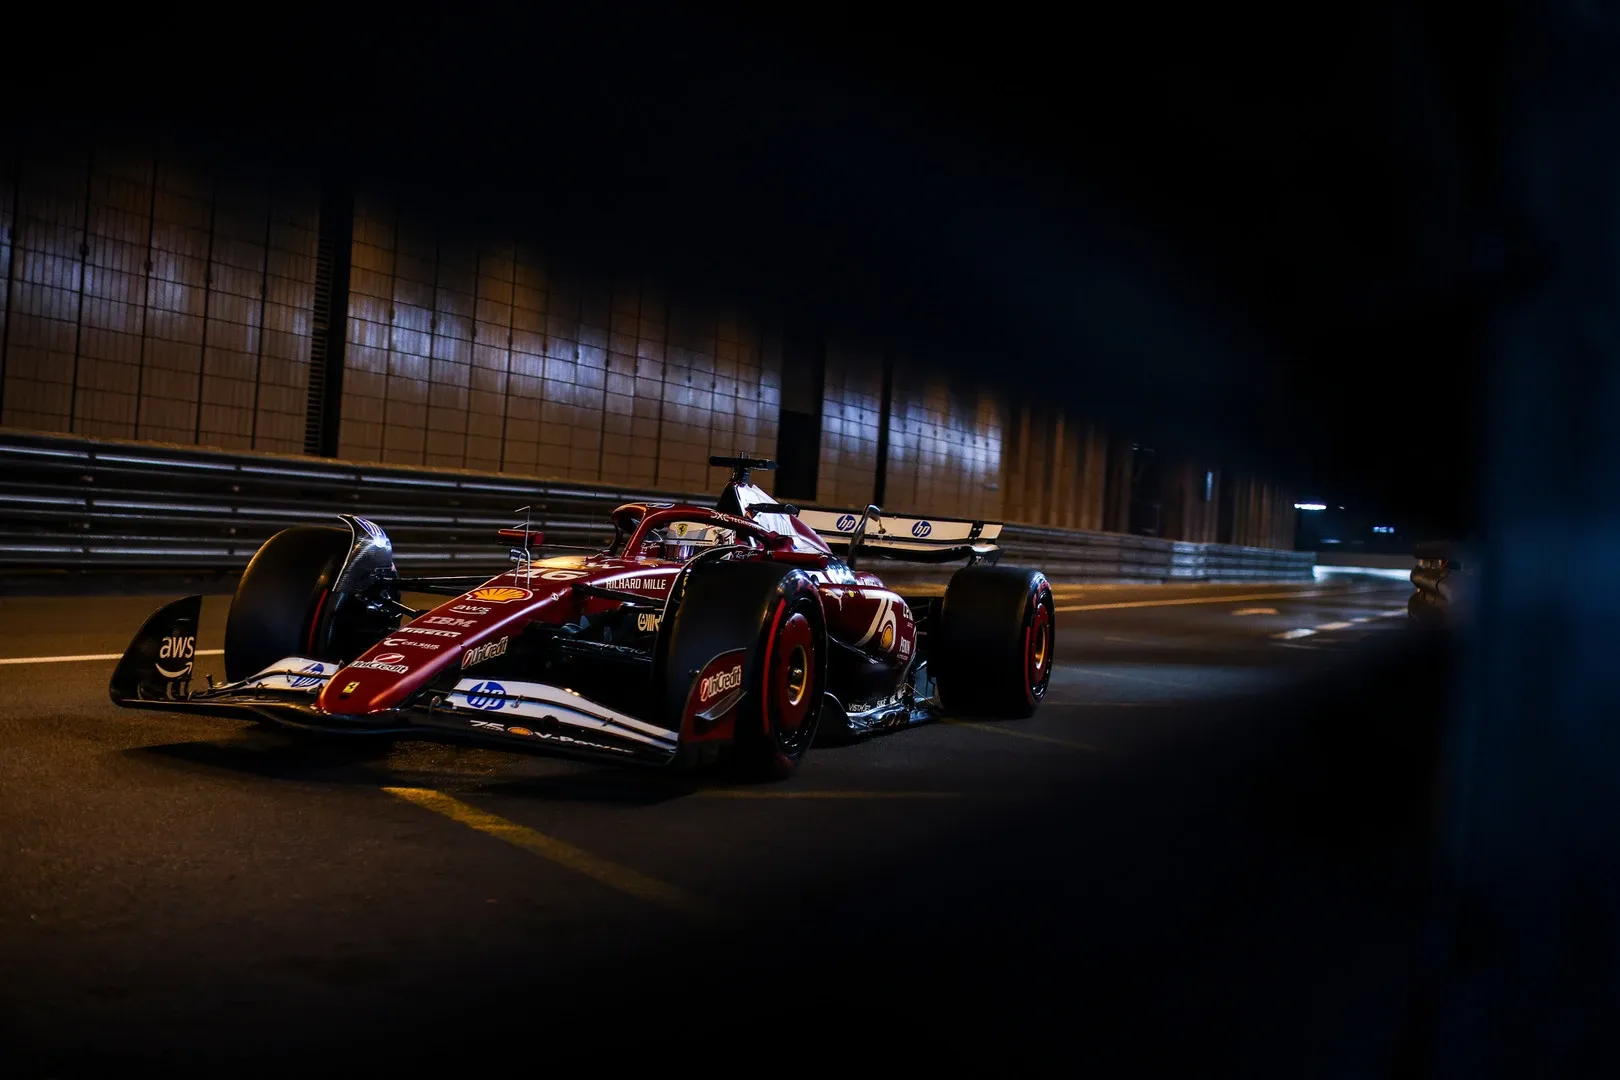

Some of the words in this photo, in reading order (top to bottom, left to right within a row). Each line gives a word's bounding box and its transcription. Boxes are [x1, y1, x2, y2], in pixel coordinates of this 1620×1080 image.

[837, 515, 855, 531] hp
[913, 521, 931, 537] hp
[606, 578, 641, 590] RICHARD
[642, 578, 667, 590] MILLE
[453, 604, 492, 612] aws
[422, 616, 478, 628] IBM
[159, 635, 195, 659] aws
[700, 664, 742, 702] UniCredit
[469, 681, 505, 710] hp
